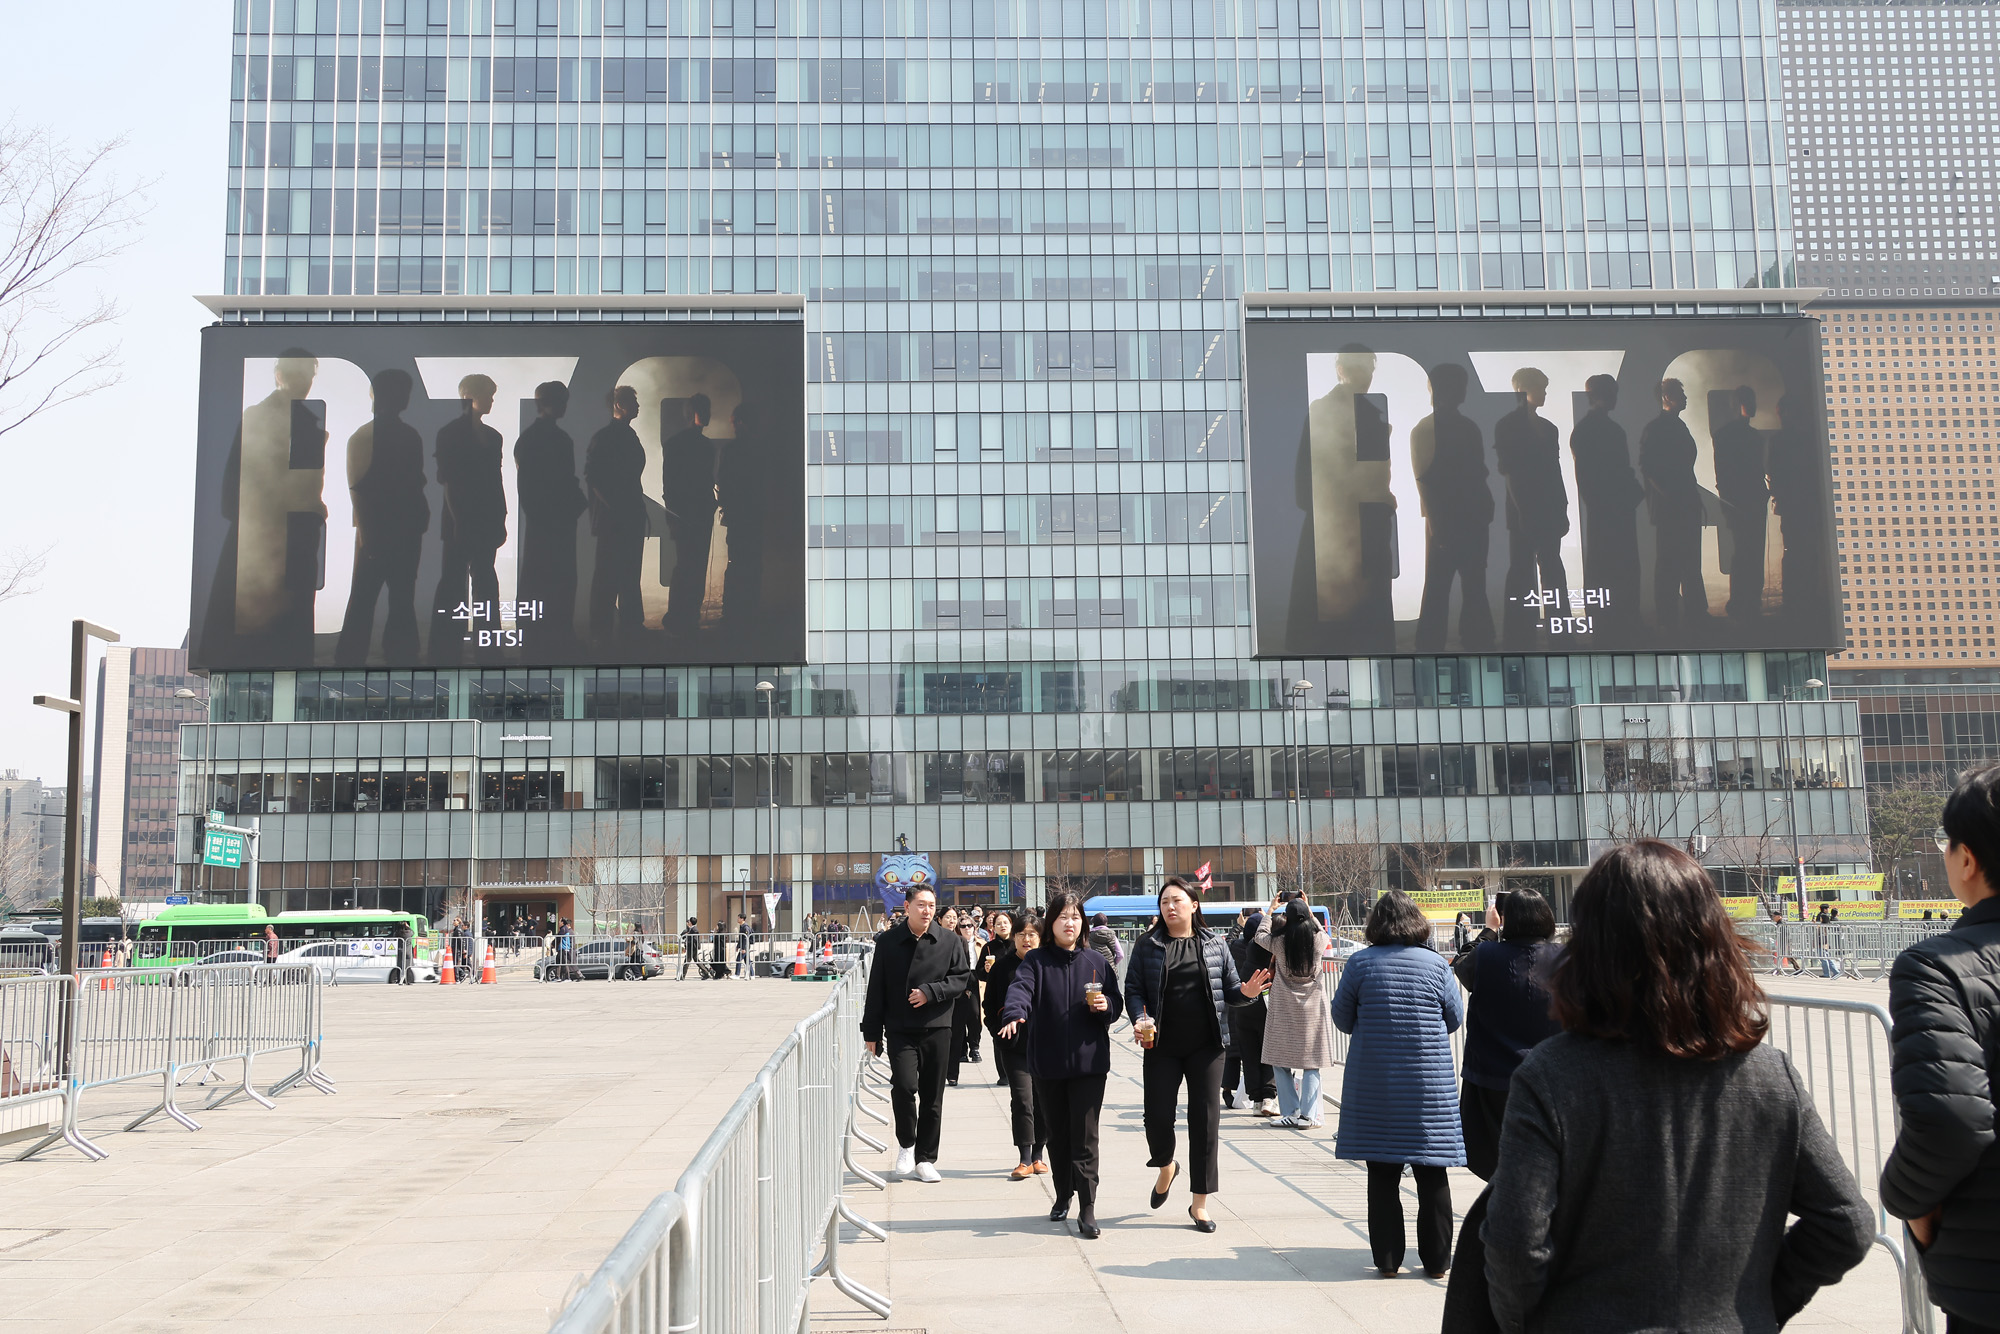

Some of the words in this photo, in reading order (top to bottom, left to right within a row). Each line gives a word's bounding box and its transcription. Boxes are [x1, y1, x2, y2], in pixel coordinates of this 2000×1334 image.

[1523, 588, 1561, 609] 소리
[1567, 588, 1611, 609] 질러!
[451, 600, 492, 622] 소리
[498, 600, 544, 622] 질러!
[1551, 616, 1594, 634] BTS!
[478, 629, 523, 647] BTS!
[506, 734, 546, 742] doughroom
[1858, 902, 1882, 910] People!
